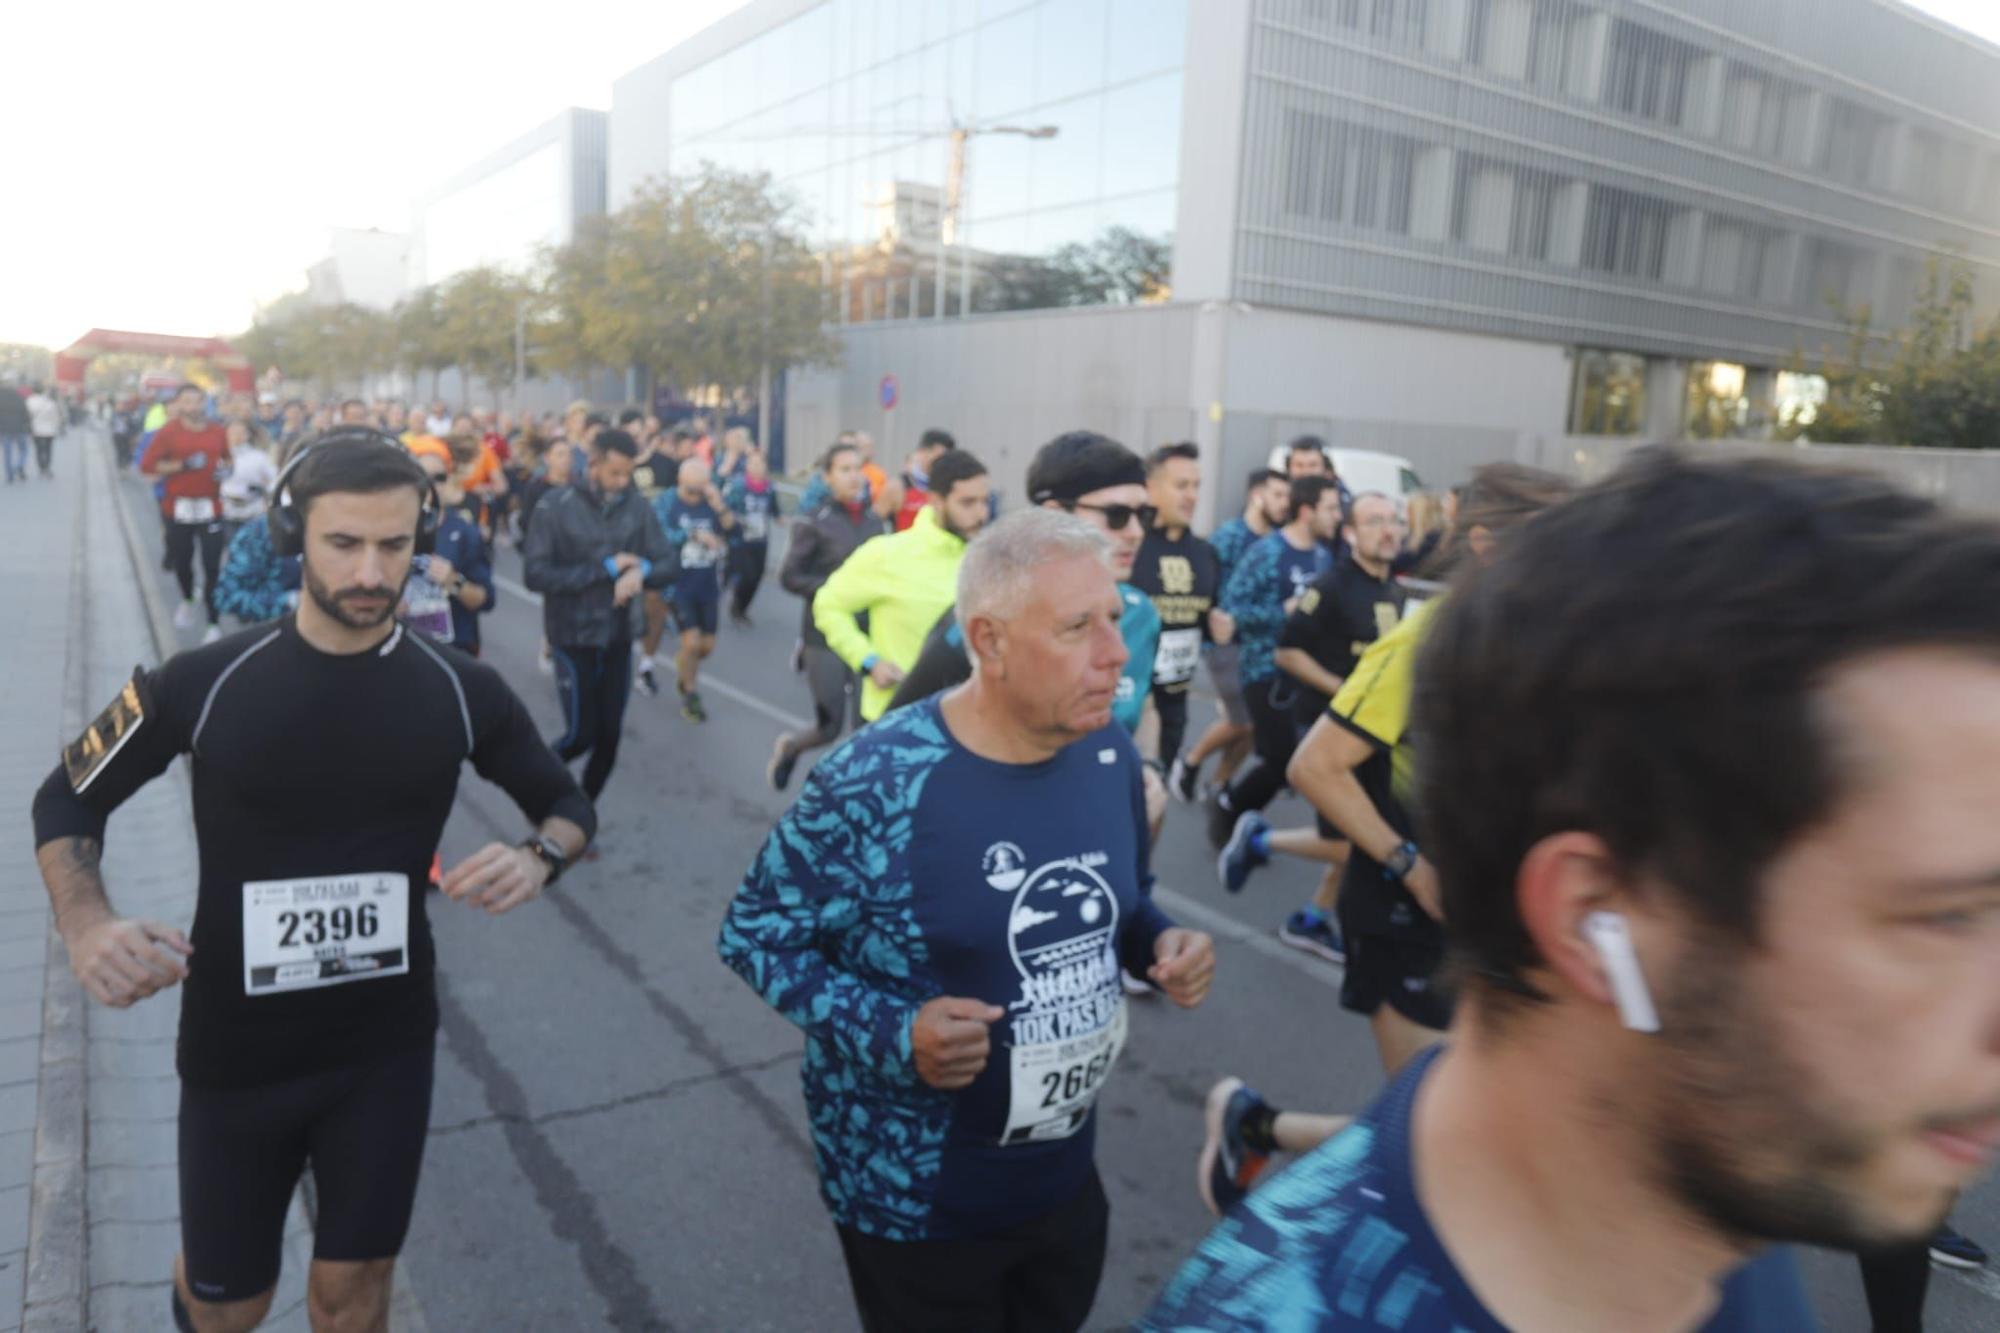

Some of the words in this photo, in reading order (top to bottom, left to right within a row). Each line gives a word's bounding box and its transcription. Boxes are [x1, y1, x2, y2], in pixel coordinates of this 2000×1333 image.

[278, 903, 378, 947] 2396
[1010, 1016, 1058, 1045] 10K
[1057, 1000, 1096, 1041] PAS
